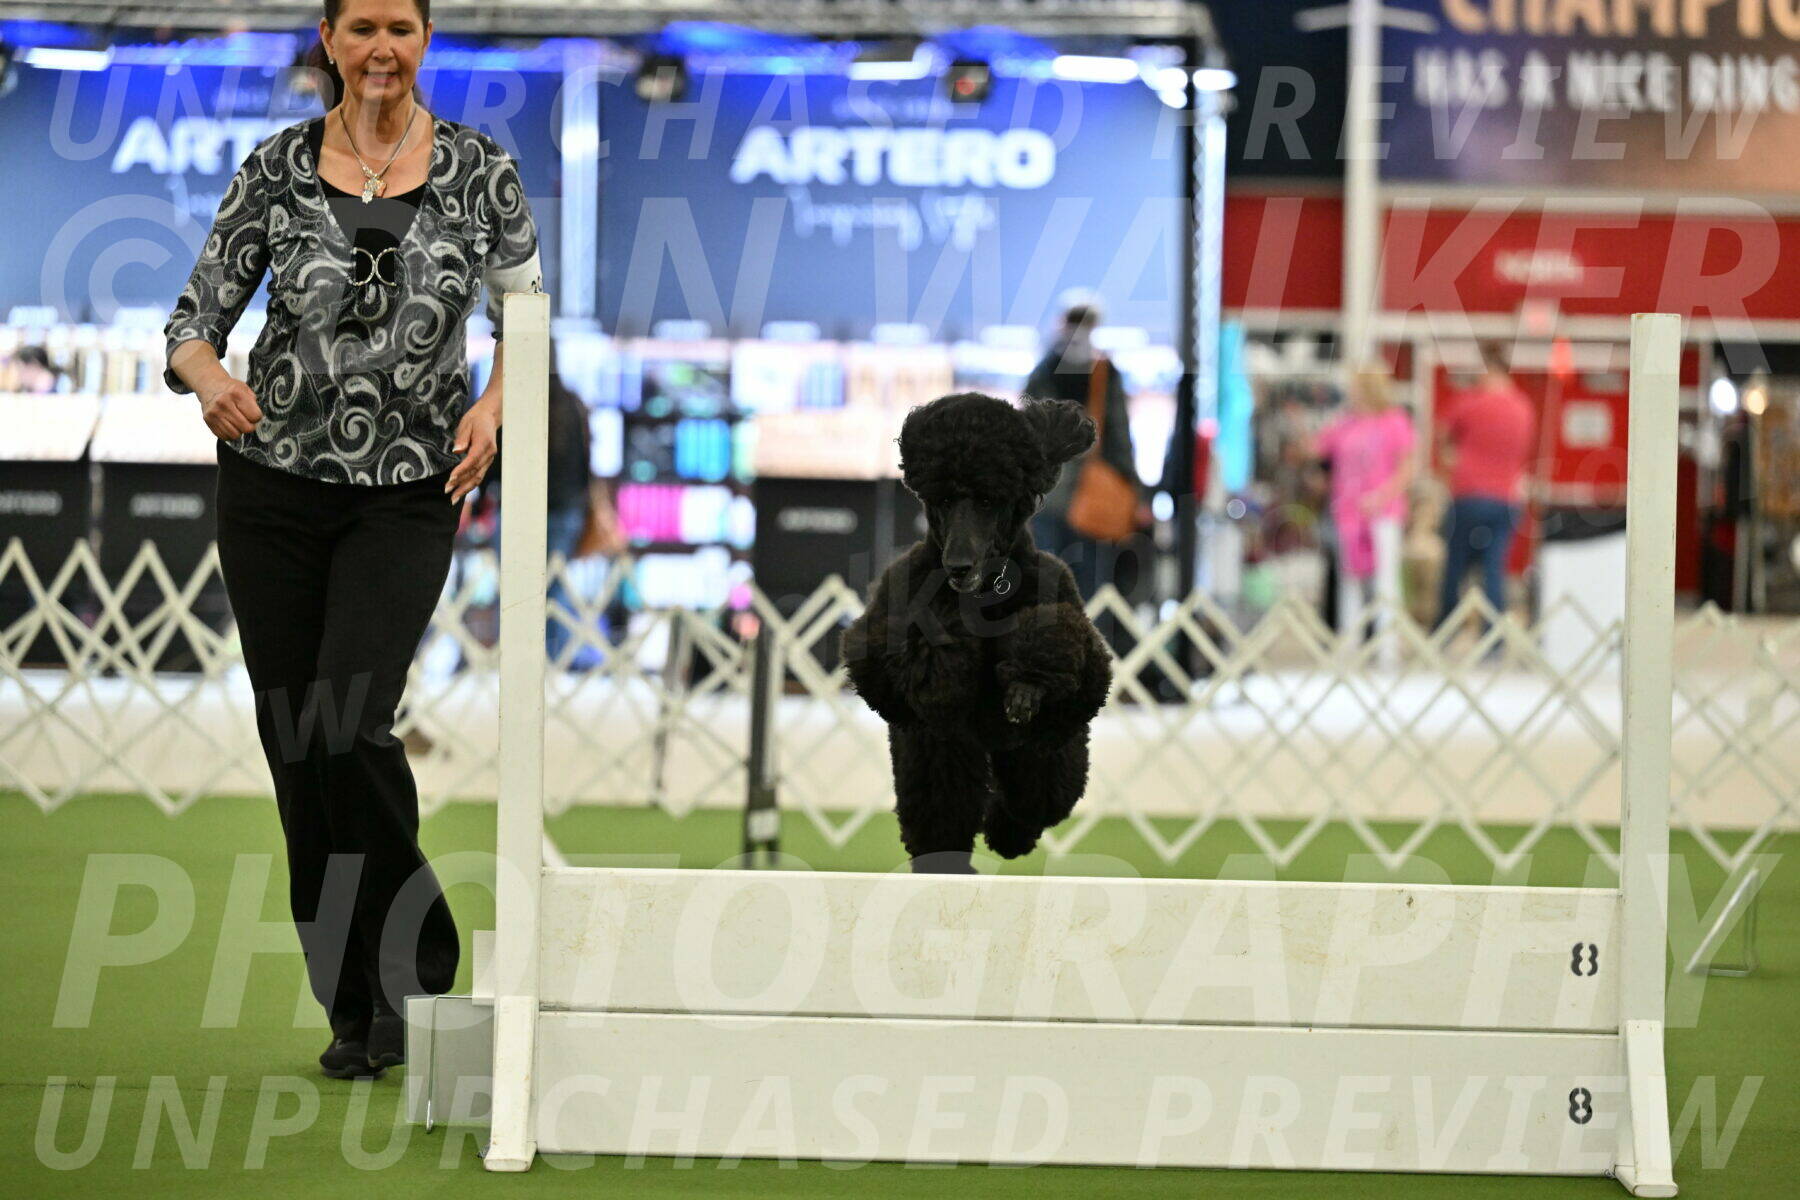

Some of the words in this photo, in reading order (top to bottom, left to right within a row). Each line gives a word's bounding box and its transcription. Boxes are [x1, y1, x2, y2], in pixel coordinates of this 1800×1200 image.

[730, 125, 1057, 190] ARTERO
[1571, 942, 1599, 977] 8
[1568, 1087, 1593, 1125] 8
